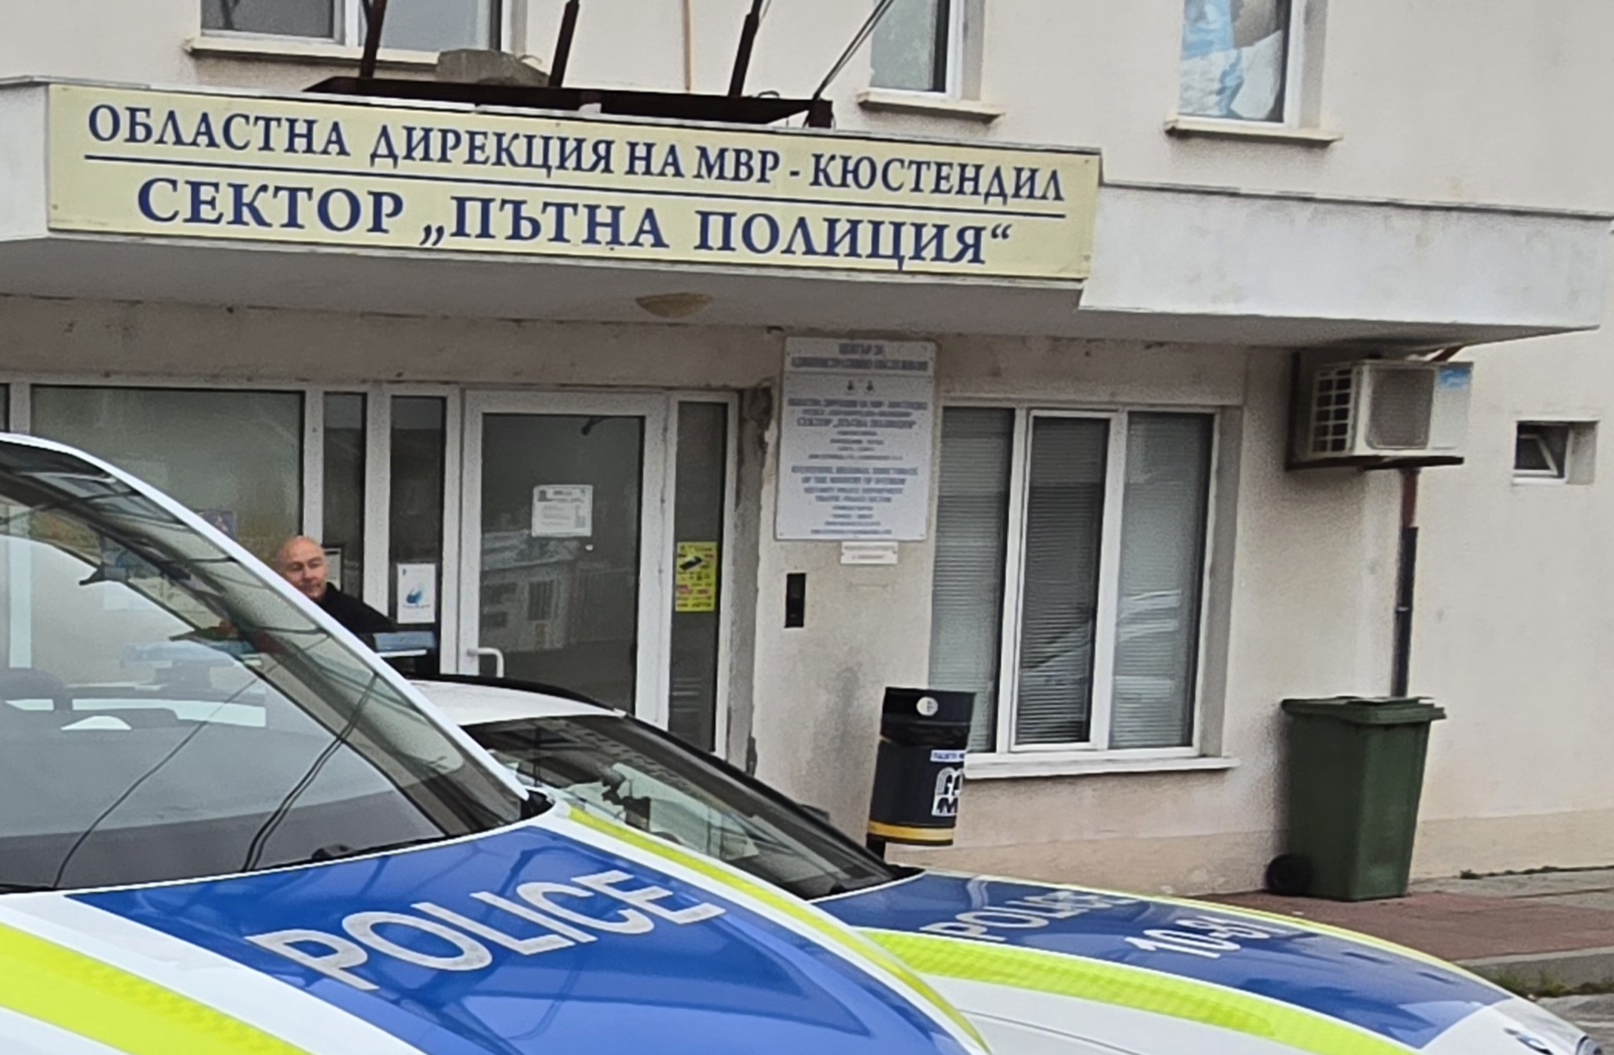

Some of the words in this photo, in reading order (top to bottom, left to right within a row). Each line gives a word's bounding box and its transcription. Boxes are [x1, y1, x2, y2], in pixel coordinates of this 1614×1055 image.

[87, 103, 351, 157] ОБЛАСТНА
[369, 123, 615, 178] ДИРЕКЦИЯ
[623, 140, 686, 179] НА
[694, 144, 781, 185] МВР
[809, 152, 1065, 206] КЮСТЕНДИЛ
[137, 176, 404, 234] СЕКТОР
[418, 195, 670, 249] „ПЪТНА
[693, 209, 1013, 271] ПОЛИЦИЯ“
[243, 869, 727, 991] POLICE
[1124, 915, 1304, 959] 10-81
